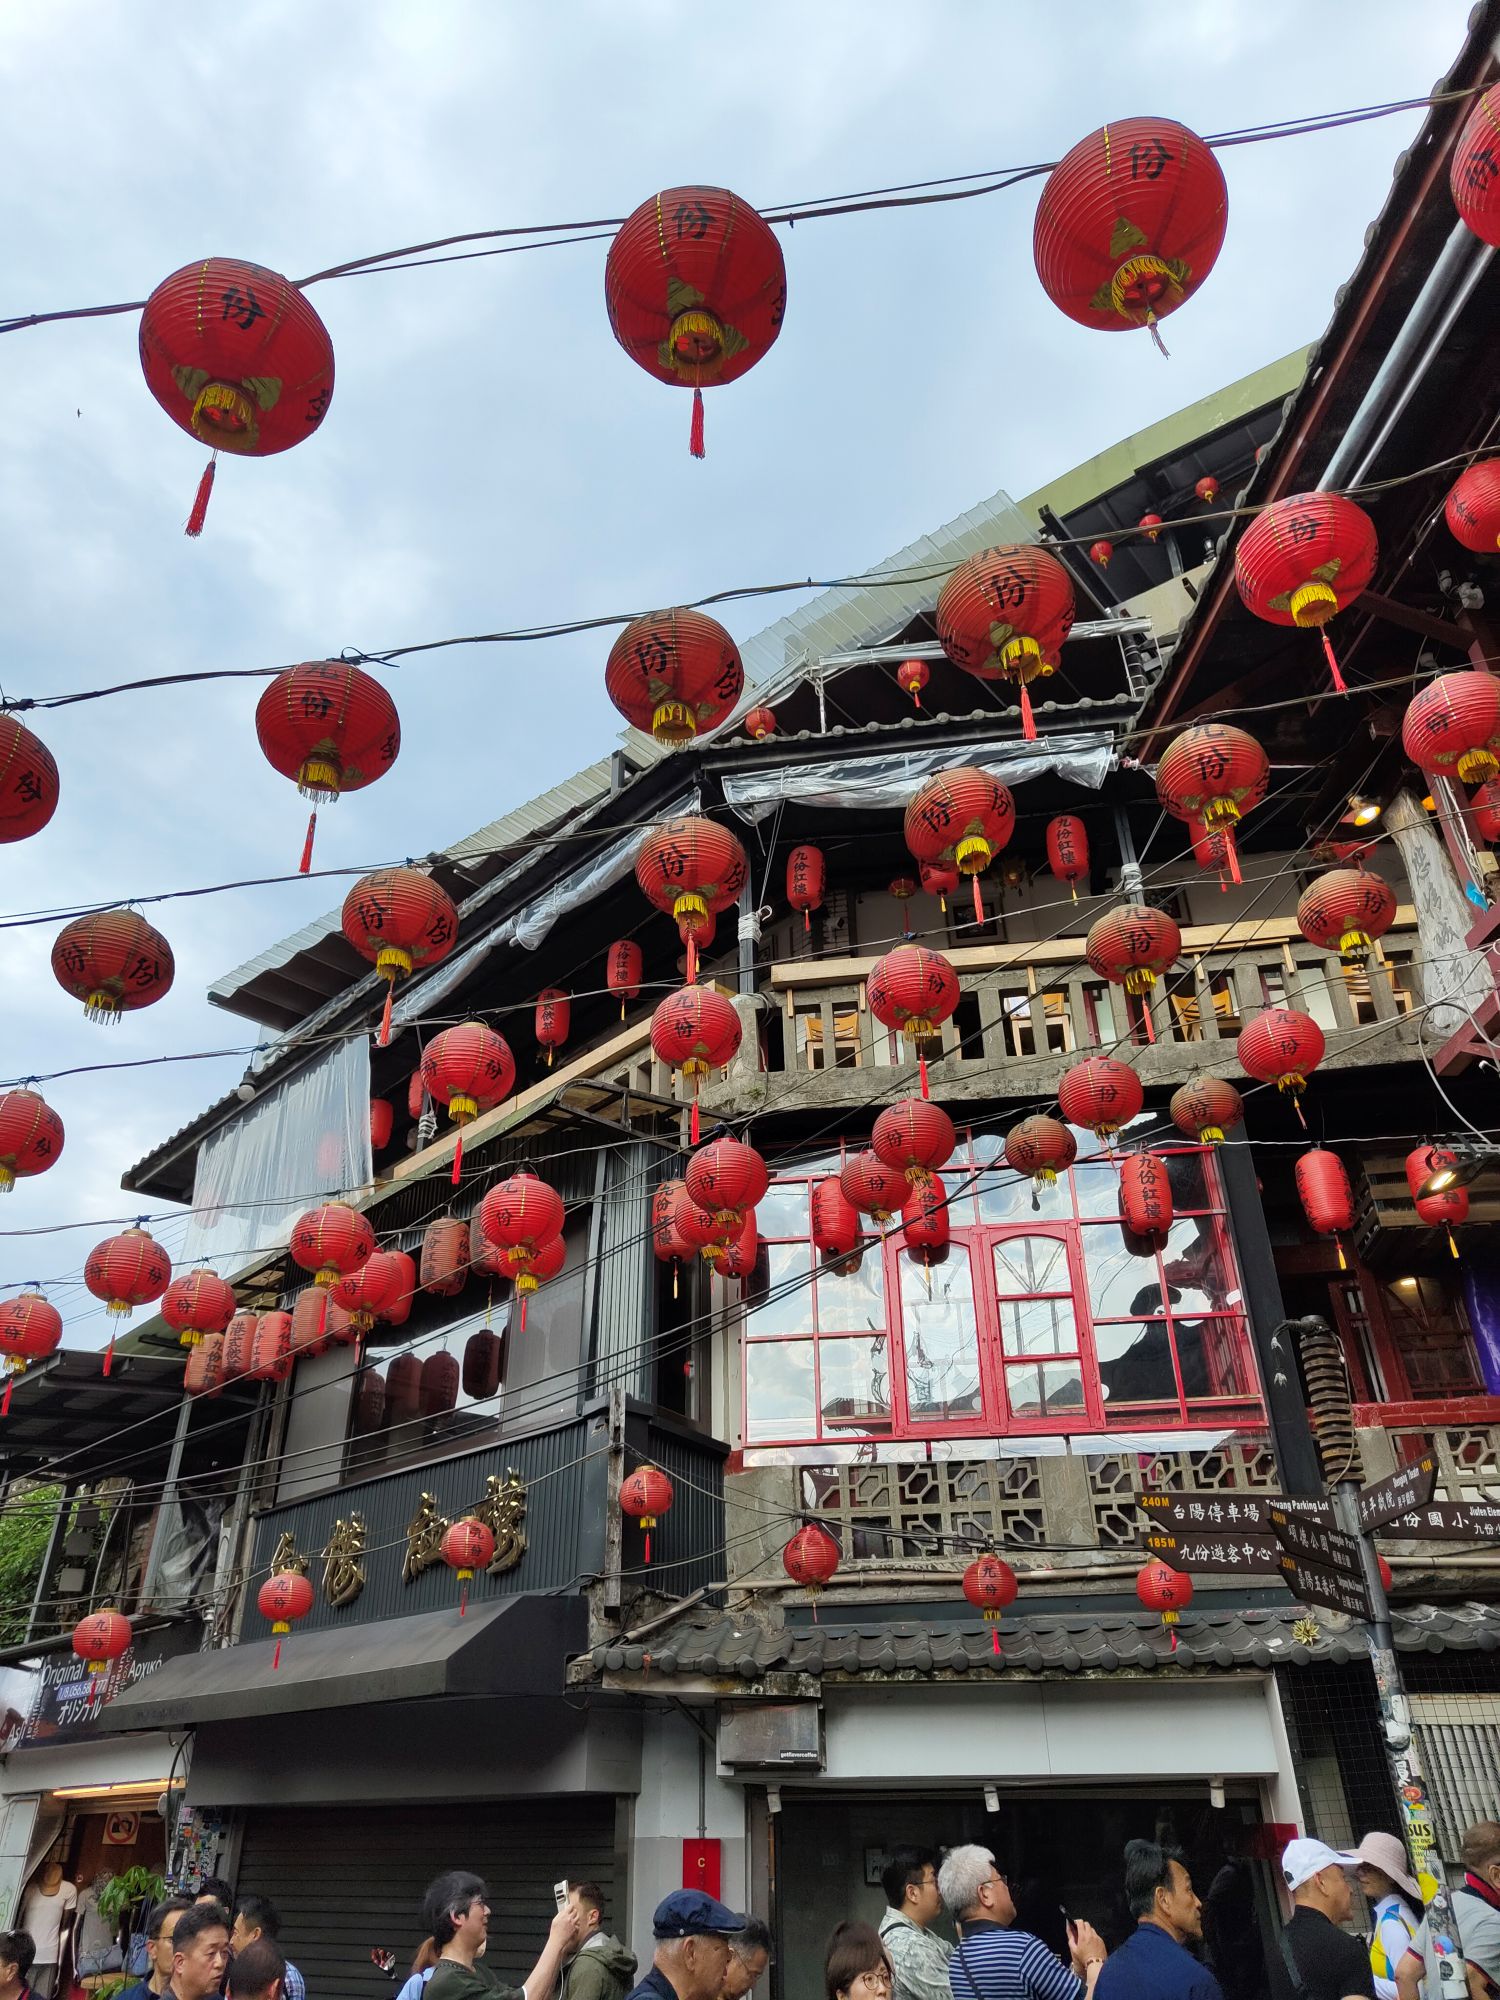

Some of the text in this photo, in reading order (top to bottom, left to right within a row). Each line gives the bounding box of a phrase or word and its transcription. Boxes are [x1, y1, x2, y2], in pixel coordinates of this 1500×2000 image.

[1127, 139, 1173, 180] 份
[672, 203, 717, 240] 份
[220, 286, 268, 331] 份
[1056, 817, 1076, 865] 九份紅樓
[792, 850, 809, 896] 九份紅樓
[616, 942, 631, 981] 九份紅樓
[926, 951, 947, 994] 九份
[674, 994, 696, 1038] 九份
[1276, 1010, 1298, 1056] 九份
[1099, 1060, 1120, 1103] 九份
[886, 1101, 905, 1148] 九份
[699, 1143, 716, 1191] 九份
[497, 1182, 518, 1227] 九份
[1138, 1155, 1160, 1219] 九份紅樓
[176, 1278, 195, 1313] 九份
[5, 1303, 27, 1340] 九份
[632, 1479, 645, 1507] 九份
[1142, 1496, 1169, 1507] 240M
[1292, 1500, 1317, 1512] Parking
[1318, 1501, 1329, 1511] Lot
[1469, 1506, 1487, 1516] Jiufen
[1173, 1502, 1260, 1523] 台陽停車場
[1148, 1537, 1176, 1548] 185M
[1180, 1542, 1272, 1564] 九份遊客中心
[274, 1579, 288, 1608] 九份
[983, 1564, 997, 1596] 九份
[1158, 1569, 1174, 1600] 九份
[91, 1620, 107, 1649] 九份
[42, 1660, 86, 1690] Original
[57, 1696, 102, 1725] オリジナル
